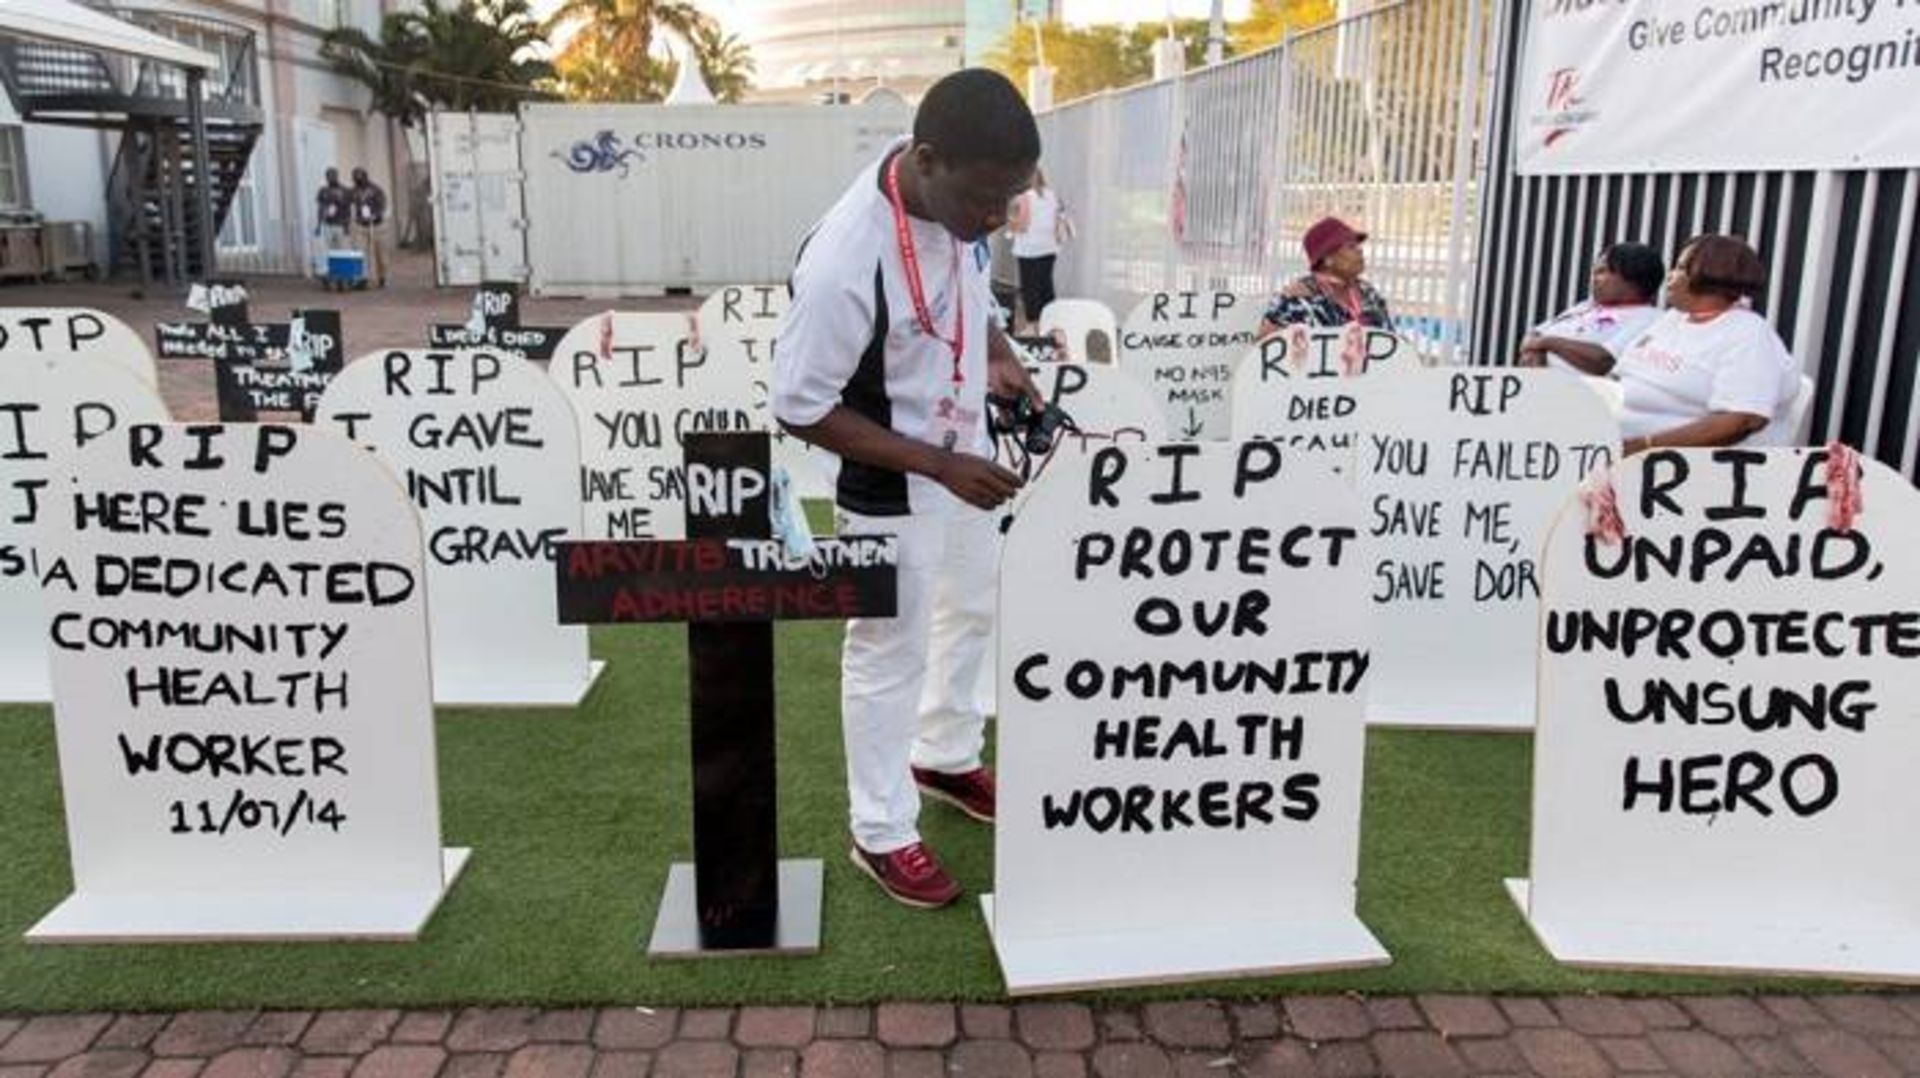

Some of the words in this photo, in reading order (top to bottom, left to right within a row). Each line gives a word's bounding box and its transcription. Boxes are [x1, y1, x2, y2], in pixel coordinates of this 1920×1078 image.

[1628, 16, 1686, 51] Give
[1694, 0, 1877, 42] Community
[635, 132, 767, 149] CRONOS
[484, 291, 511, 316] RIP
[1152, 293, 1236, 321] RIP
[299, 330, 333, 360] RIP
[573, 339, 708, 388] RIP
[1124, 332, 1183, 350] CAUSE
[1260, 331, 1398, 382] RIP
[384, 351, 501, 396] RIP
[1155, 366, 1186, 383] NO
[1168, 388, 1224, 404] MASK
[1450, 374, 1522, 416] RIP
[250, 390, 291, 409] THE
[1287, 394, 1357, 421] DIED
[129, 423, 298, 474] RIP
[408, 407, 544, 452] GAVE
[595, 408, 661, 450] YOU
[1087, 440, 1282, 507] RIP
[1372, 434, 1428, 477] YOU
[1454, 438, 1560, 481] FAILED
[687, 463, 765, 517] RIP
[1639, 449, 1864, 522] RIP
[74, 491, 212, 538] HERE
[237, 499, 347, 540] LIES
[608, 508, 656, 538] ME
[1370, 494, 1442, 538] SAVE
[1464, 501, 1520, 555] ME,
[1074, 525, 1357, 580] PROTECT
[1583, 526, 1884, 583] UNPAID,
[42, 556, 78, 592] A
[95, 554, 416, 607] DEDICATED
[611, 584, 858, 619] ADHERENCE
[1373, 560, 1444, 604] SAVE
[50, 612, 349, 661] COMMUNITY
[1134, 588, 1271, 637] OUR
[1545, 607, 1920, 661] UNPROTECTE
[126, 666, 348, 714] HEALTH
[1013, 649, 1371, 702] COMMUNITY
[1603, 677, 1878, 733] UNSUNG
[117, 733, 349, 778] WORKER
[1093, 714, 1305, 761] HEALTH
[1042, 772, 1322, 834] WORKERS
[1622, 750, 1840, 819] HERO
[169, 788, 347, 837] 11/07/14
